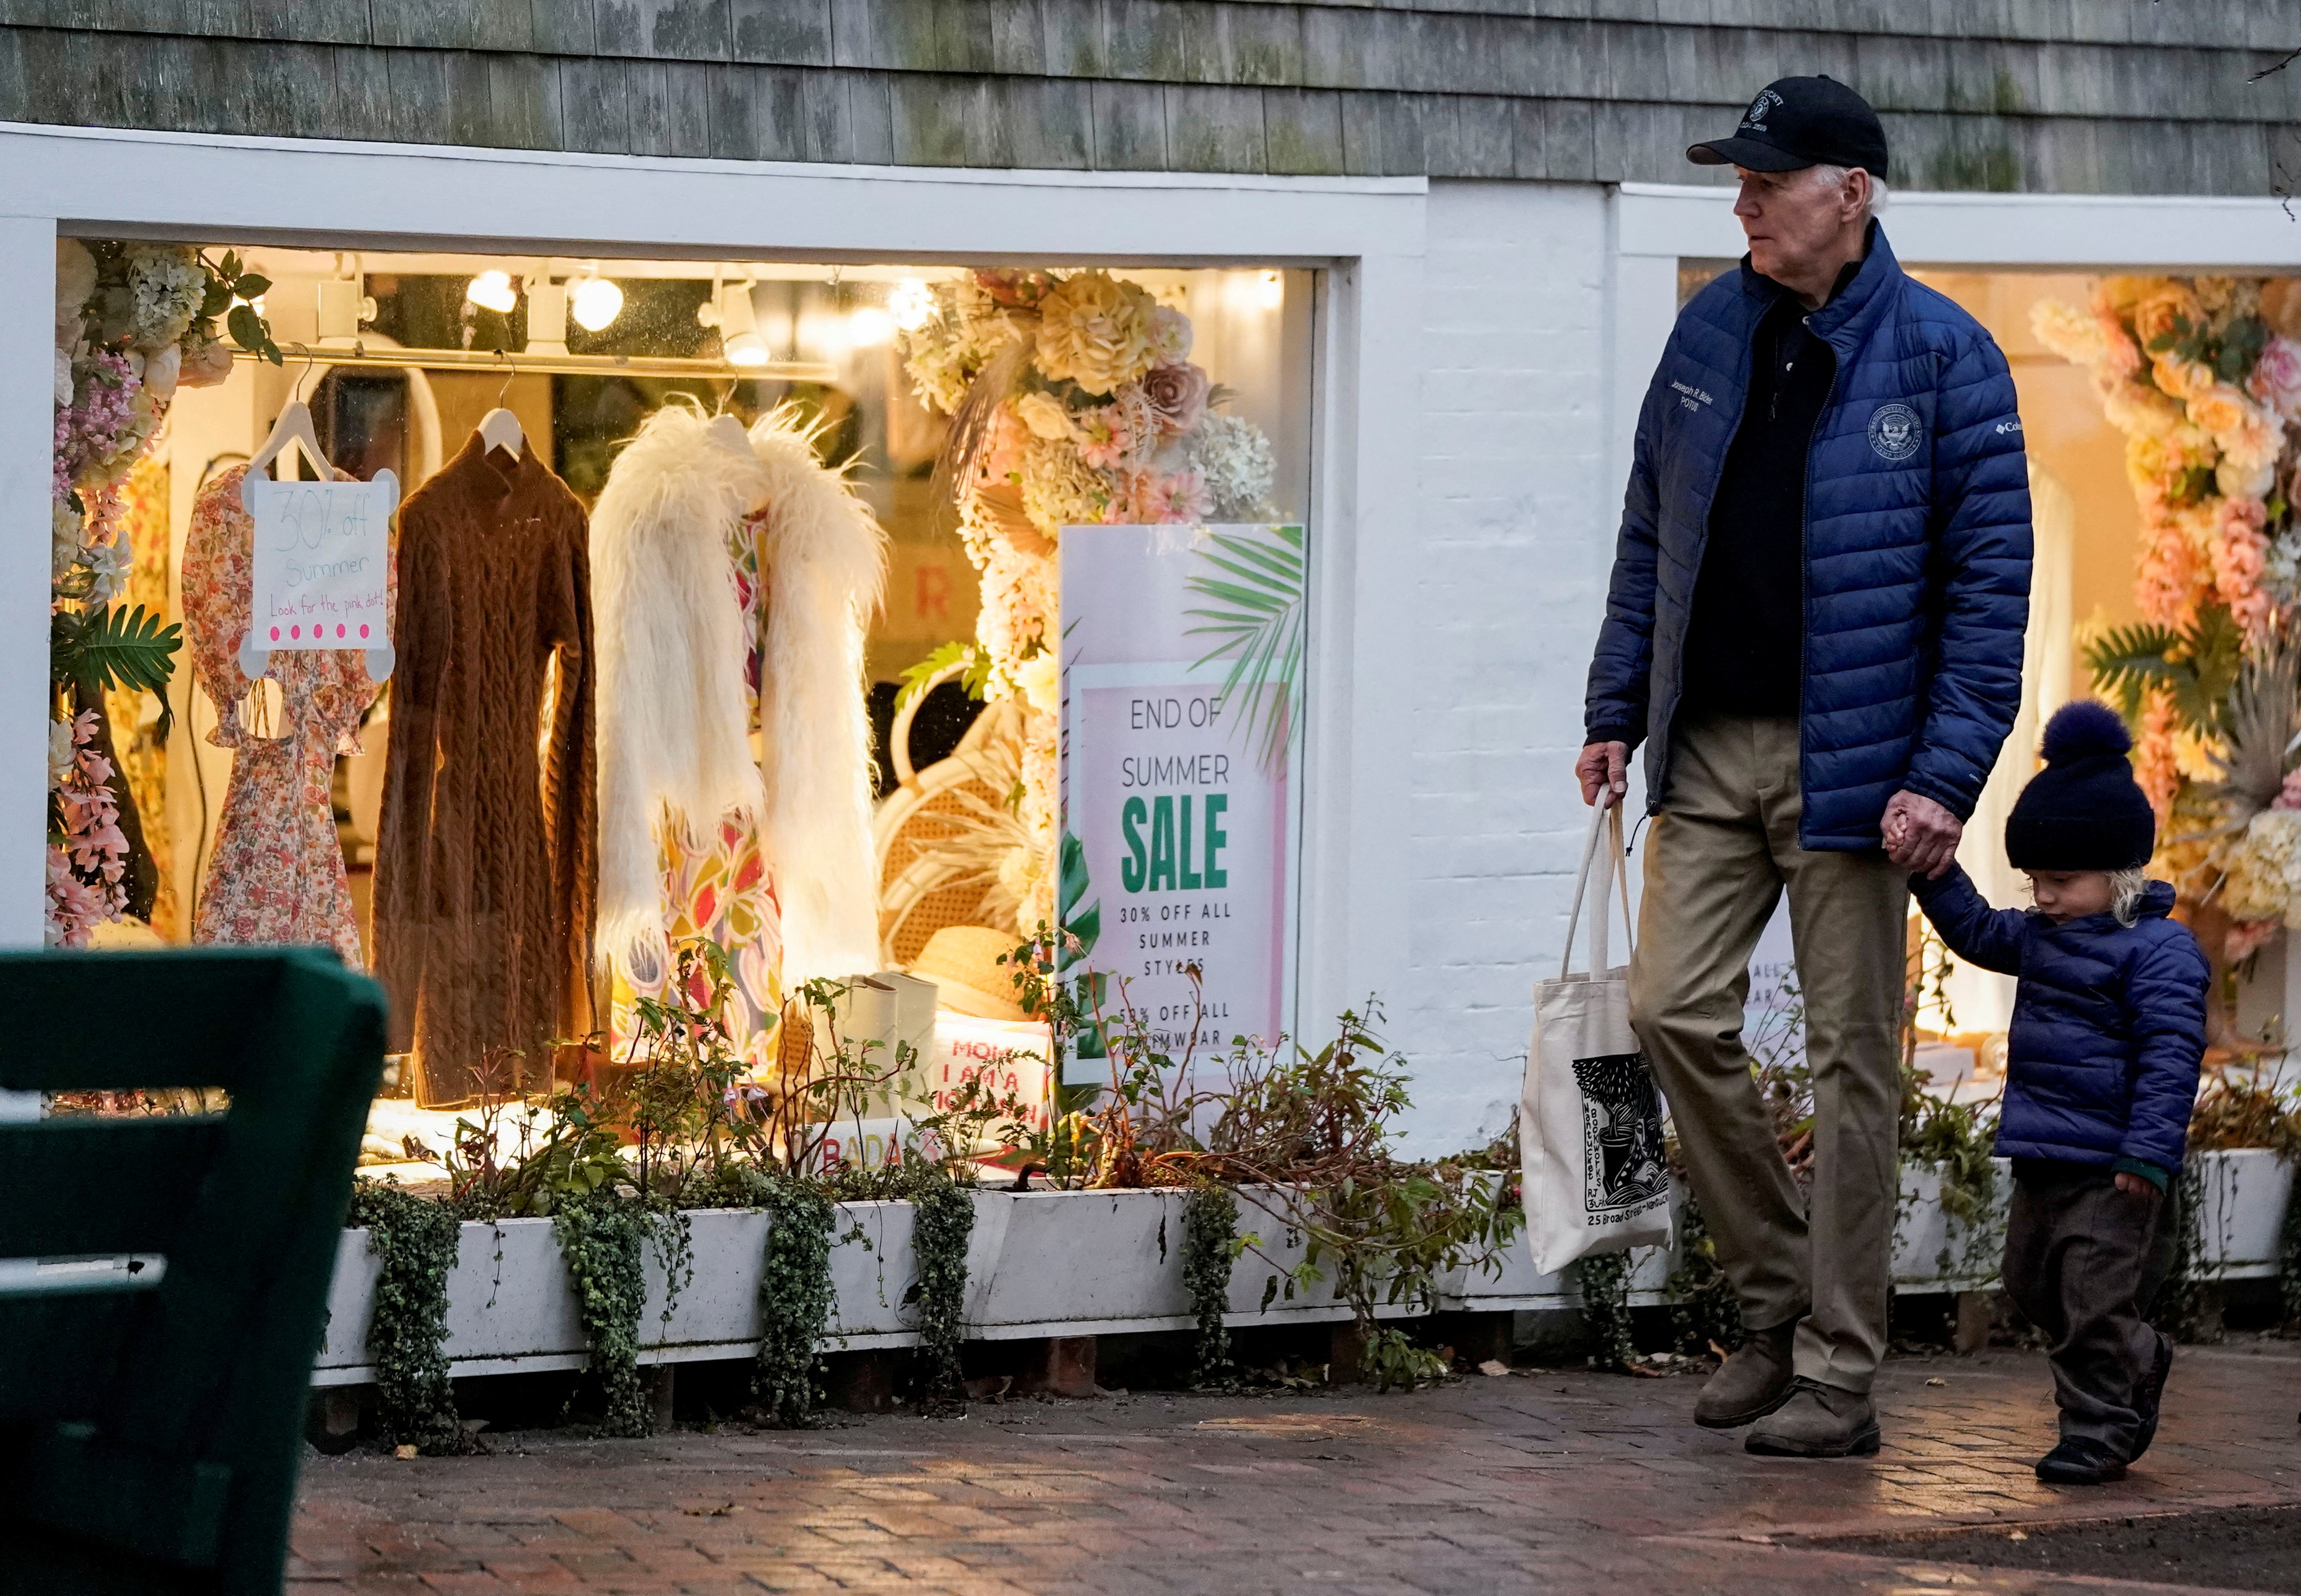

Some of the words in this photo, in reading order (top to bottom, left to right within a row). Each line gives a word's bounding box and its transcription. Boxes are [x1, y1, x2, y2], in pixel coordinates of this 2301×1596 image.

[1671, 379, 1694, 395] Joseph
[1693, 388, 1699, 398] R
[1680, 396, 1699, 412] POTUS
[272, 489, 333, 552] 30%
[342, 494, 370, 536] off
[286, 557, 370, 587] Summer
[271, 594, 297, 617] Look
[301, 594, 315, 615] for
[320, 594, 338, 612] the
[345, 595, 363, 618] pink
[366, 589, 384, 607] dot!
[1131, 699, 1181, 729] END
[1189, 698, 1222, 727] OF
[1122, 754, 1229, 787] SUMMER
[1122, 794, 1227, 893] SALE
[1120, 907, 1150, 923] 30%
[1161, 904, 1191, 920] OFF
[1202, 903, 1230, 918] ALL
[1139, 930, 1209, 949] SUMMER
[1160, 1005, 1189, 1021] OFF
[1201, 1002, 1229, 1018] ALL
[943, 1063, 949, 1082] I
[1003, 1071, 1019, 1092] A
[1584, 1103, 1593, 1180] Nantucket
[1588, 1215, 1601, 1226] 25
[1603, 1212, 1624, 1225] Broad
